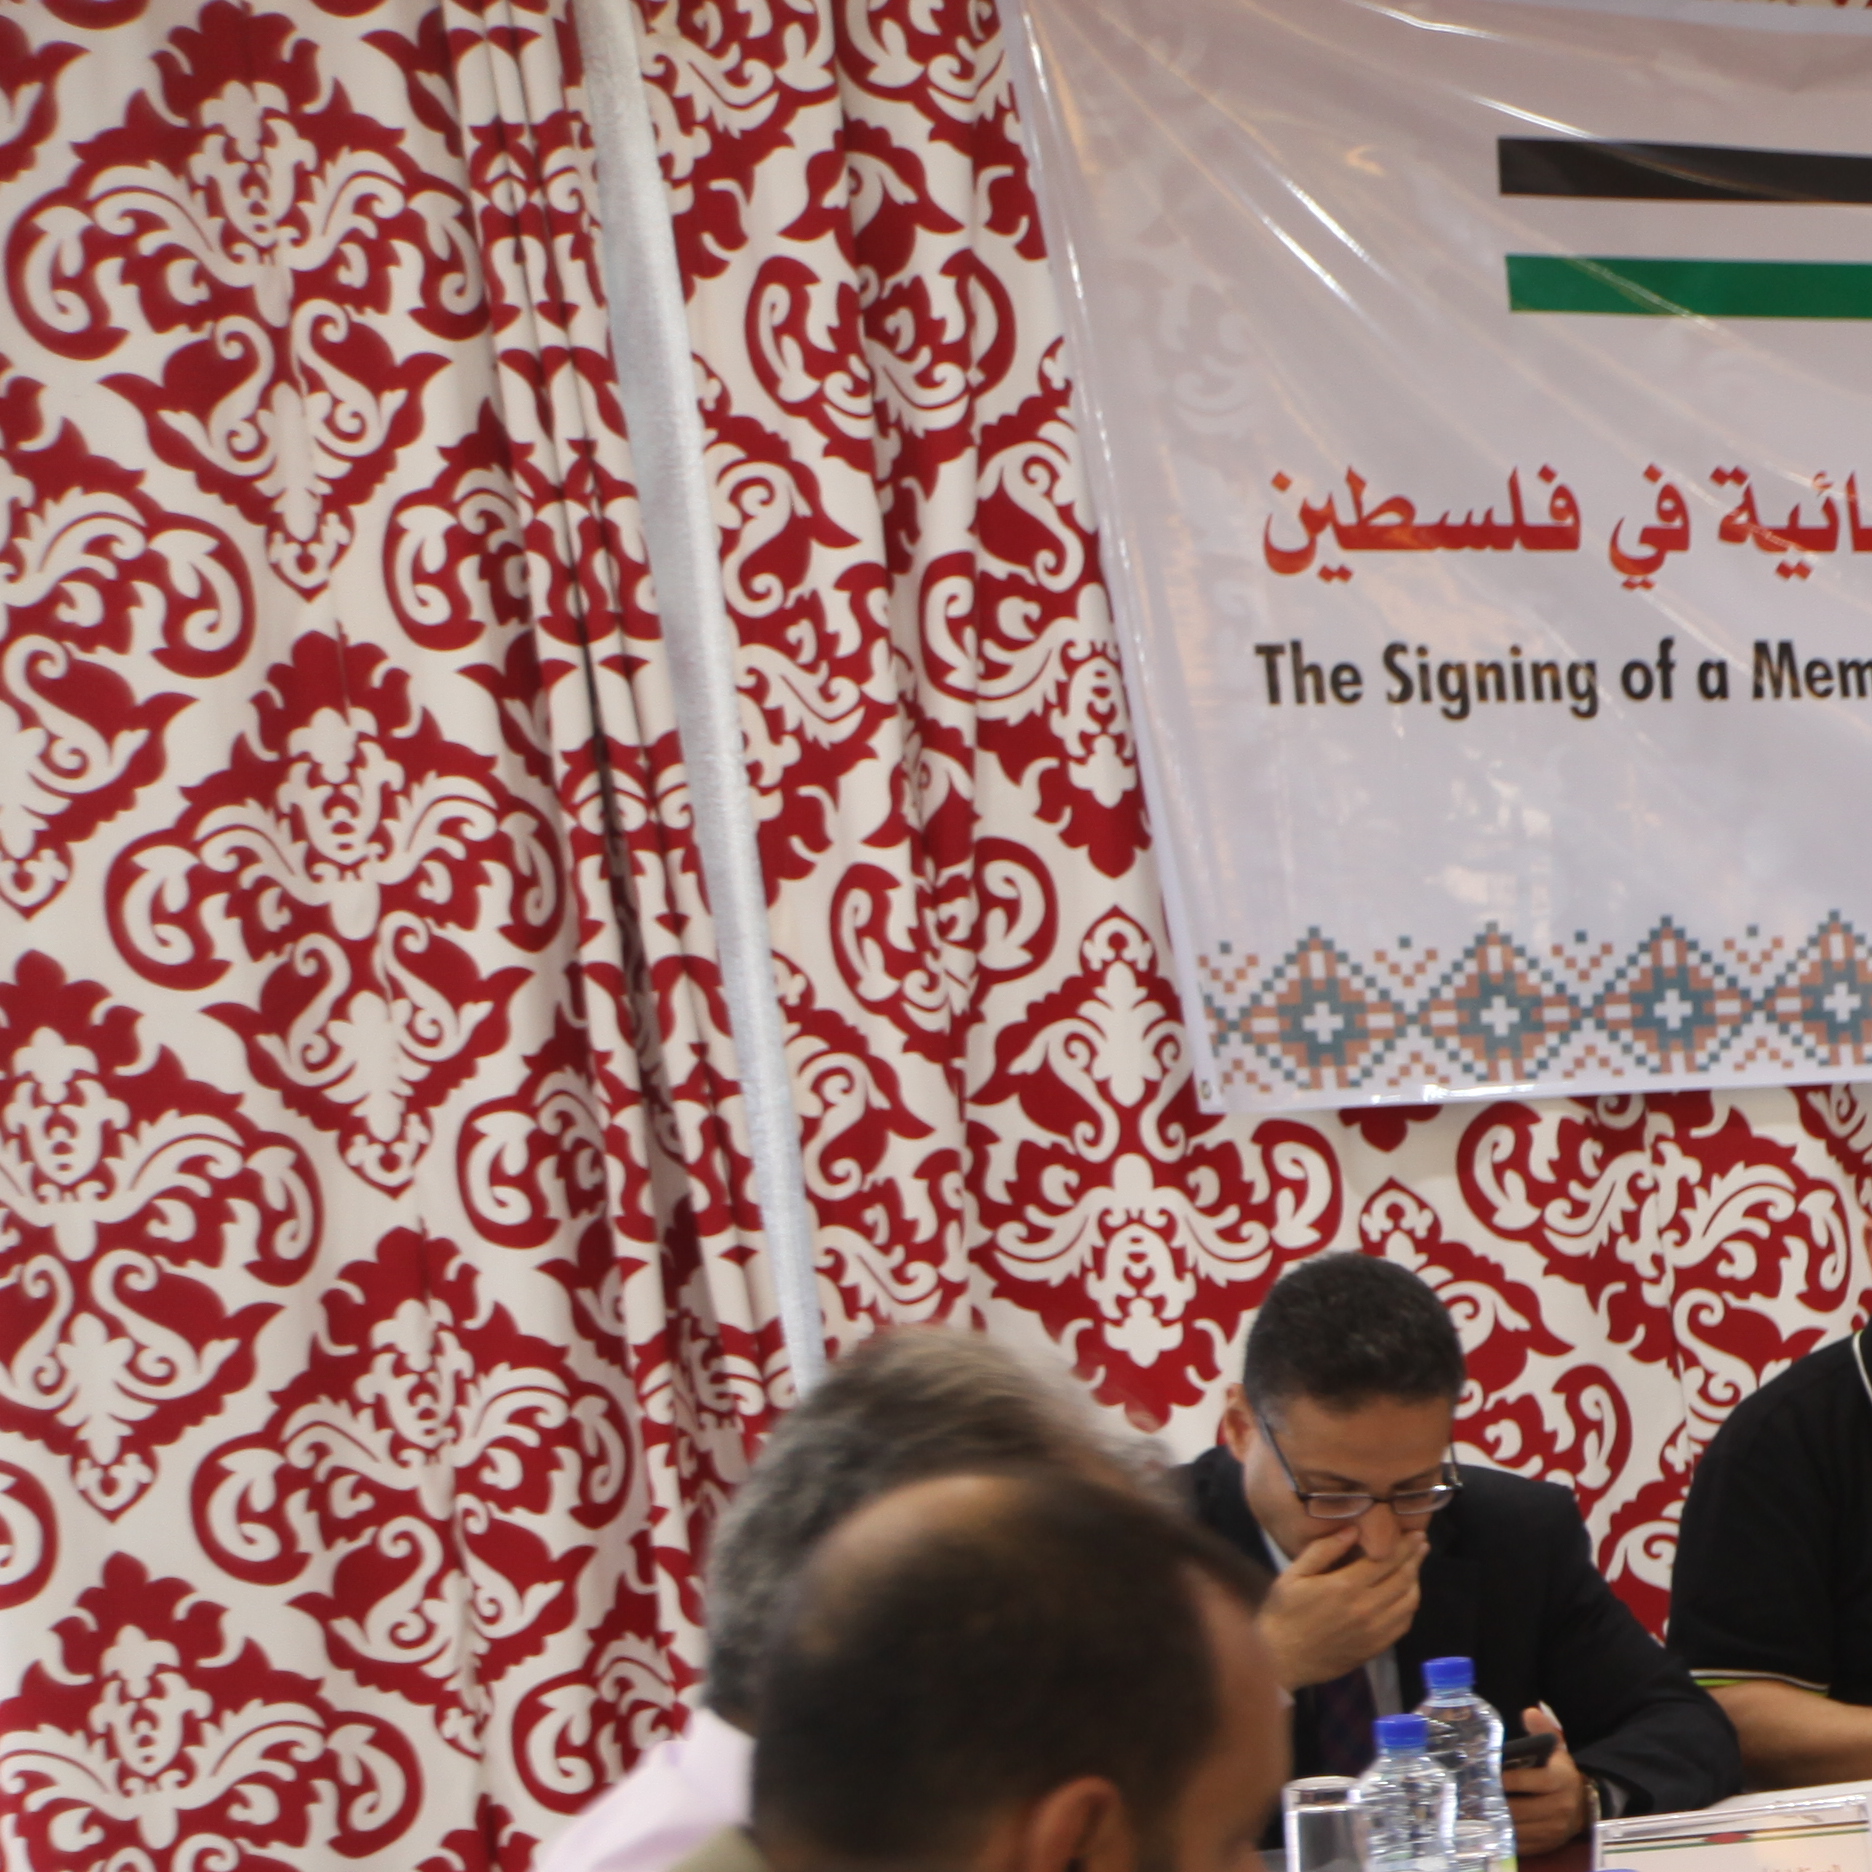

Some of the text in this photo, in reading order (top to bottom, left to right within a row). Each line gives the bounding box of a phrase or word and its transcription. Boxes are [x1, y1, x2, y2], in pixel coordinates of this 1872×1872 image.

[1263, 465, 1582, 582] فلسطين
[1609, 464, 1691, 590] في
[1254, 640, 1363, 705] The
[1382, 642, 1598, 721] Signing
[1620, 637, 1675, 702] of
[1697, 660, 1729, 701] a
